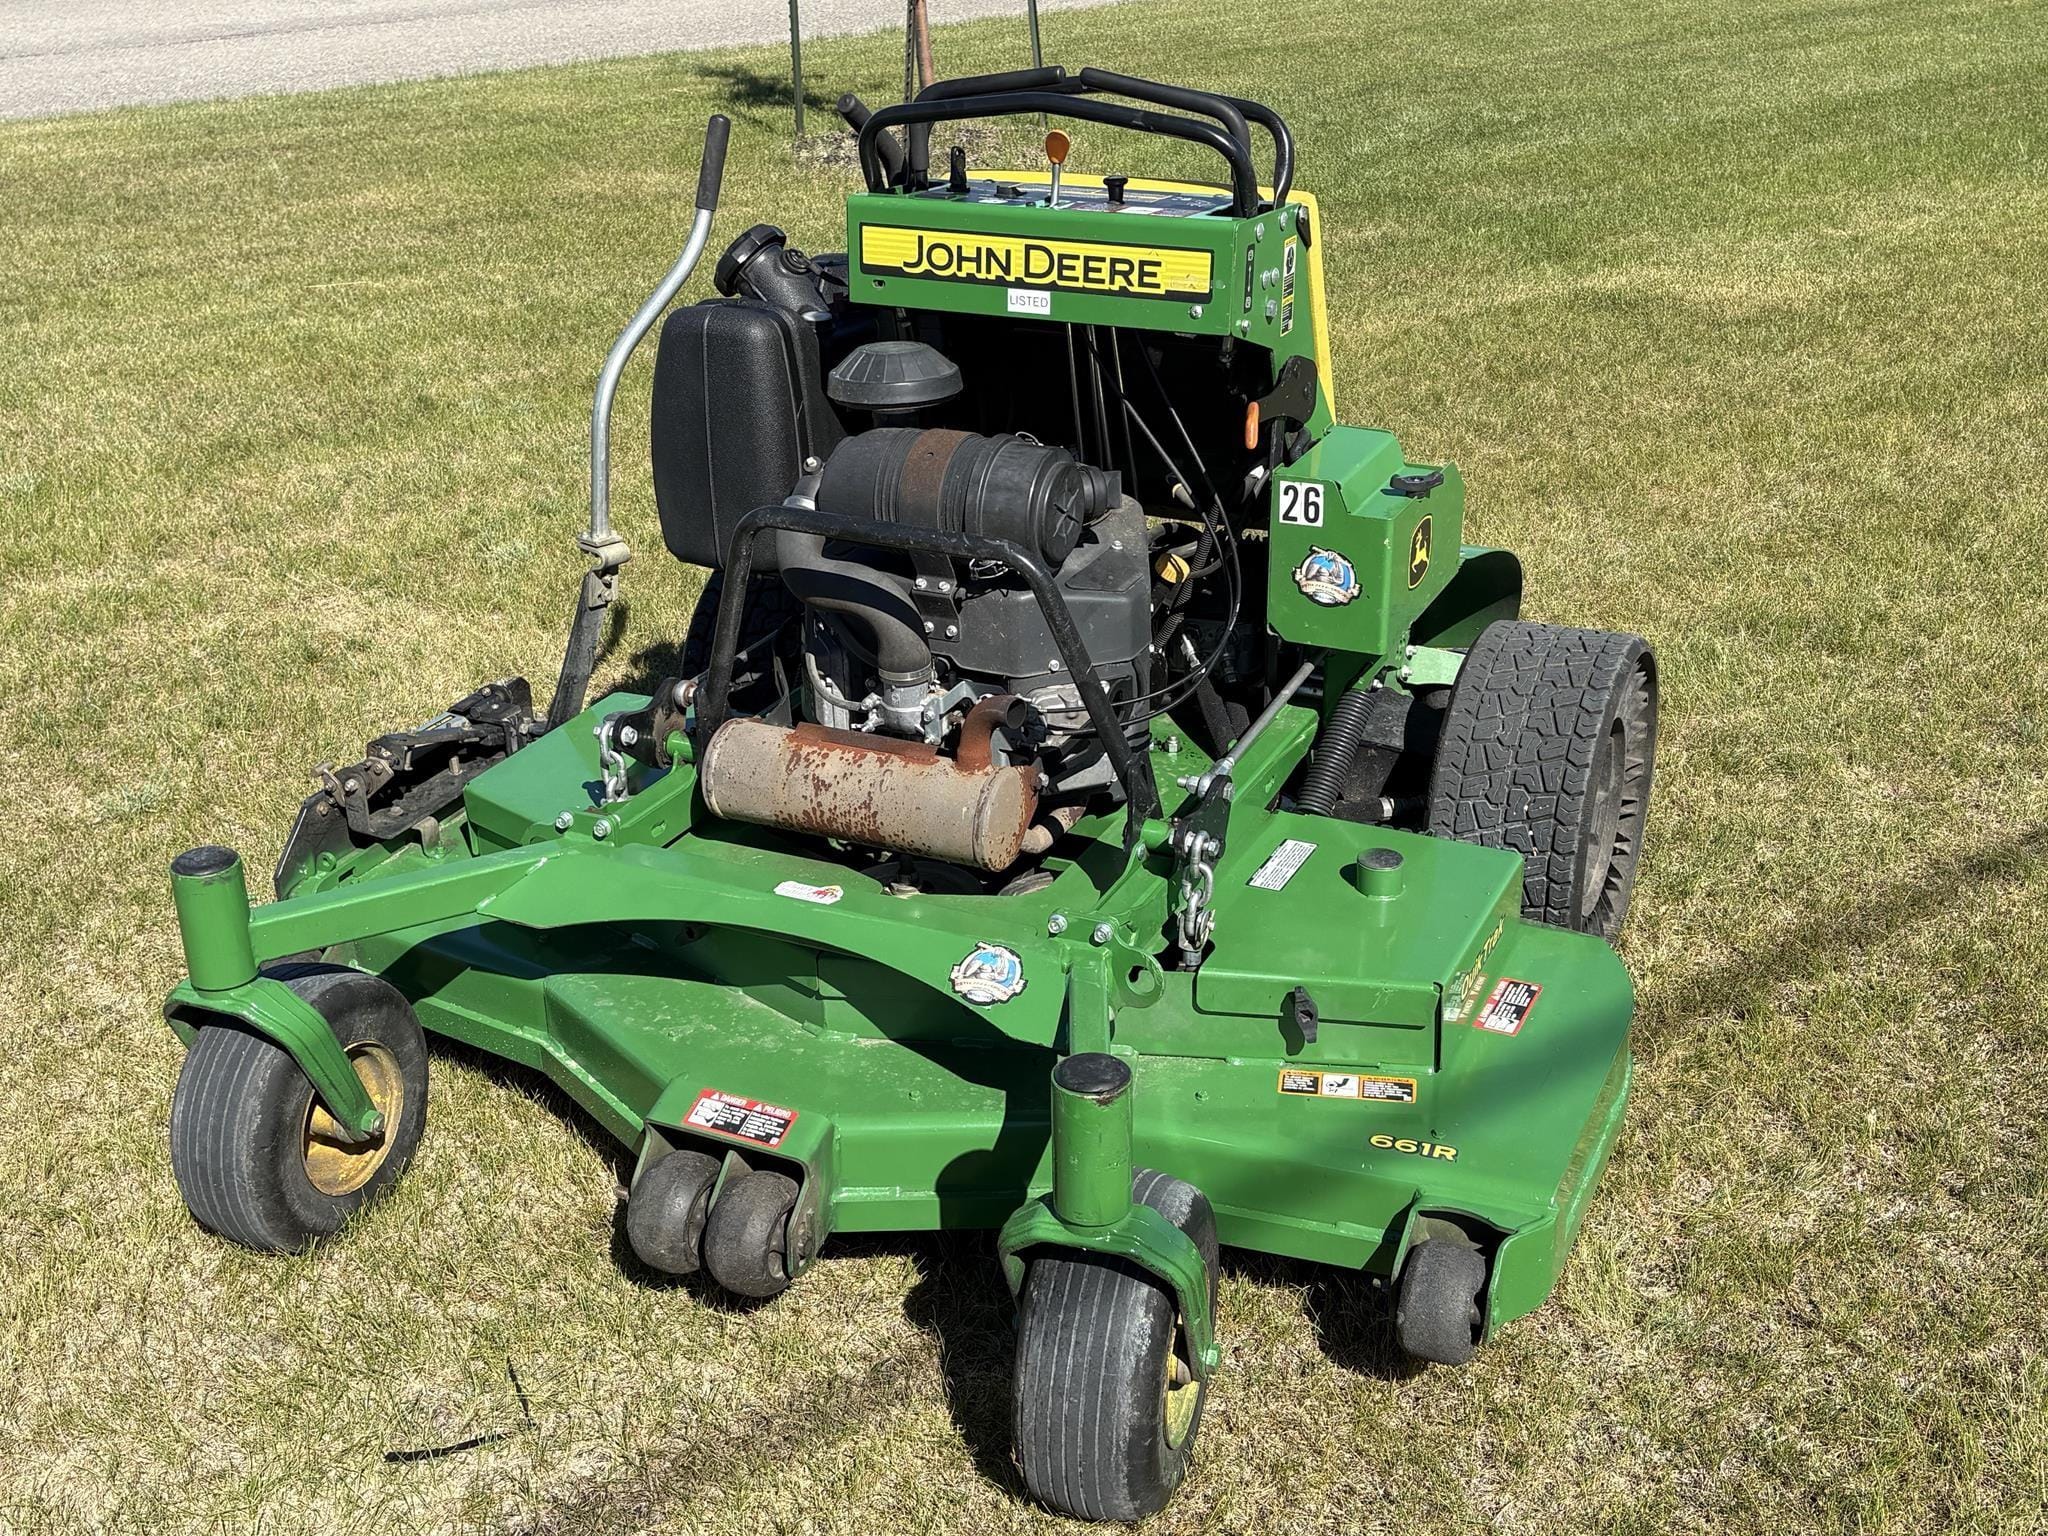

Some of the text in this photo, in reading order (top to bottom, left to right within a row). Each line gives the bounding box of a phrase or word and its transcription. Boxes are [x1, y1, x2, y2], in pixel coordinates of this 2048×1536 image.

[903, 235, 1162, 289] JOHN DEERE
[1009, 295, 1049, 308] LISTED
[1282, 484, 1320, 524] 26
[1369, 1134, 1457, 1161] 661R
